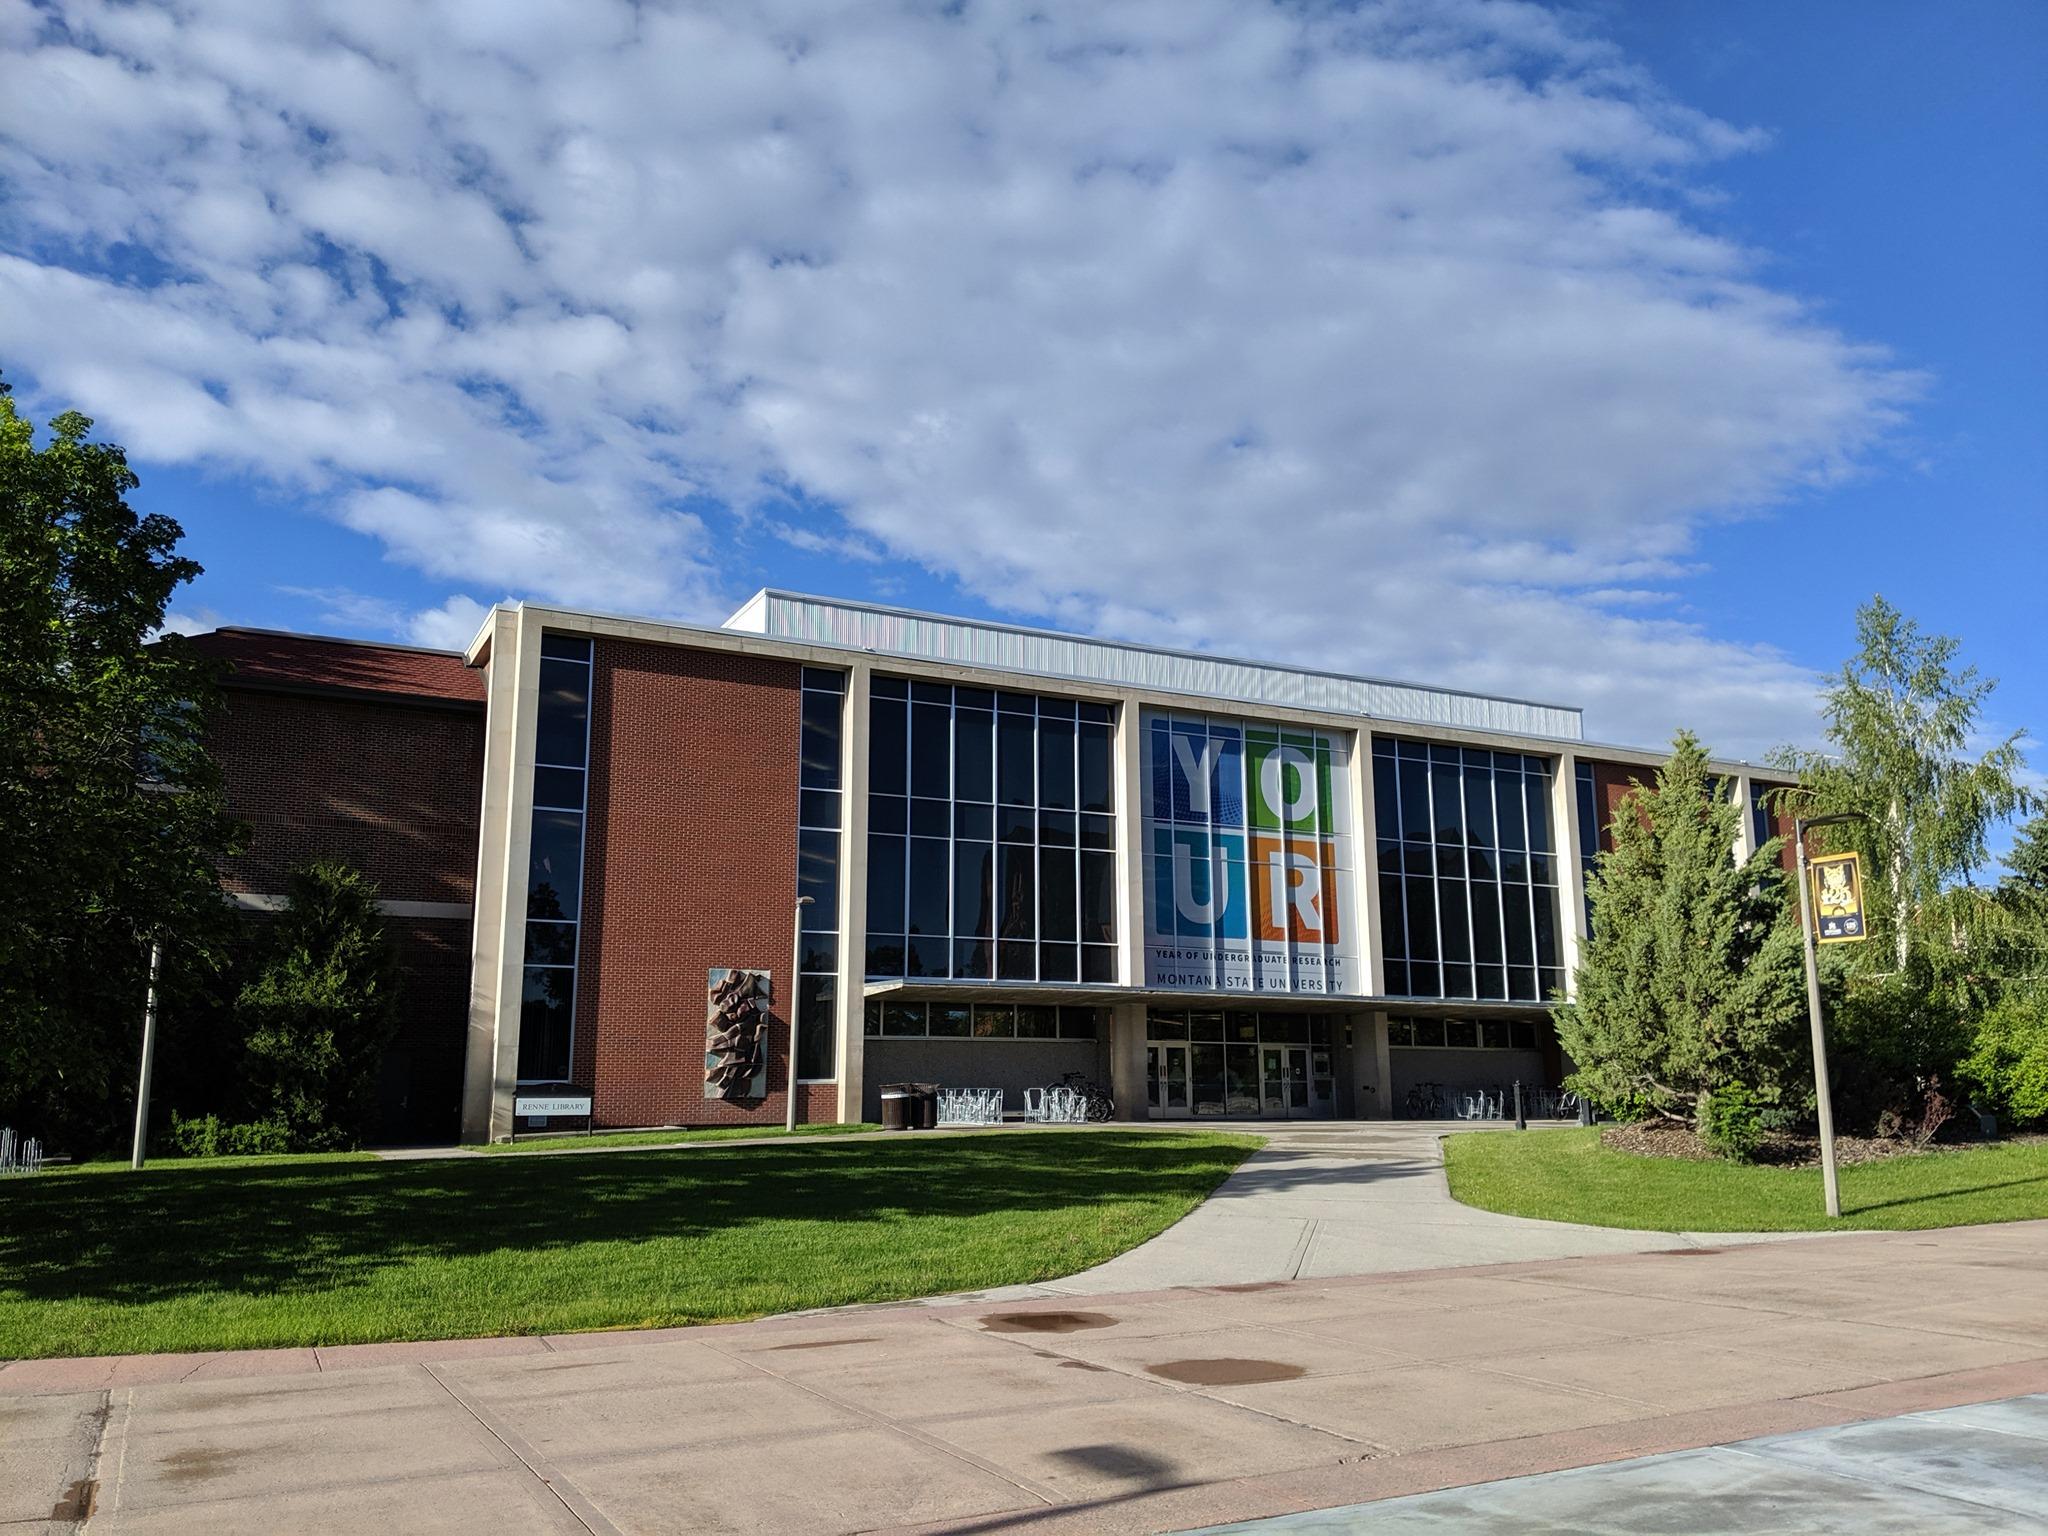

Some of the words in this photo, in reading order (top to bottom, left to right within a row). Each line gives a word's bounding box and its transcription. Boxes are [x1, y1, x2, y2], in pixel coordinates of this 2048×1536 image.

[1156, 950, 1182, 959] YEAR
[1186, 951, 1199, 960] OF
[1269, 978, 1343, 991] UNVERSTY
